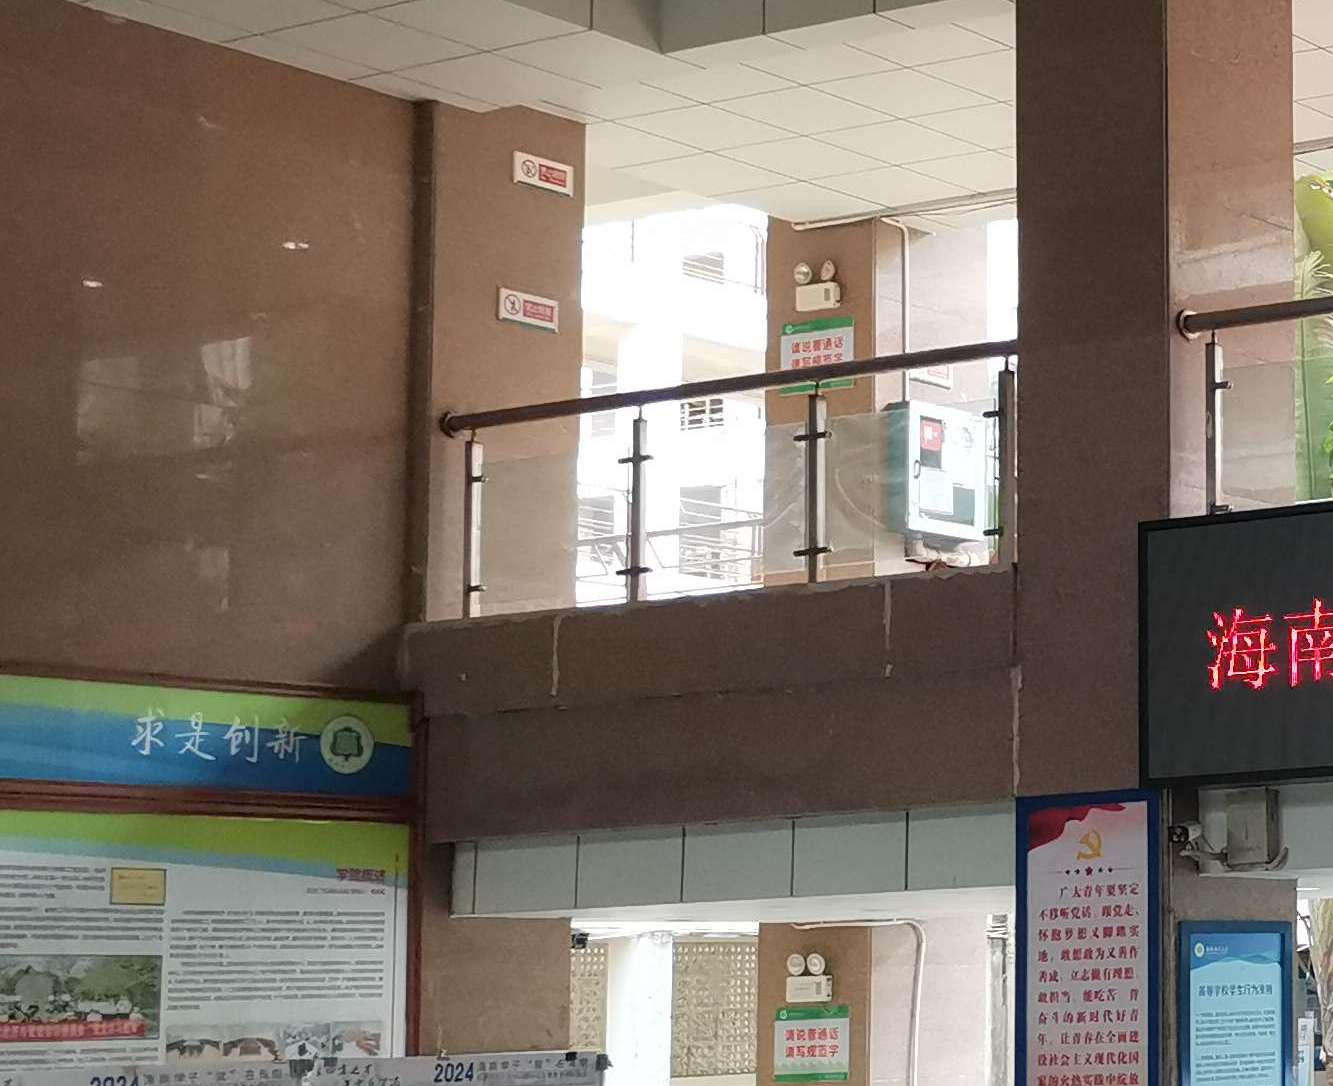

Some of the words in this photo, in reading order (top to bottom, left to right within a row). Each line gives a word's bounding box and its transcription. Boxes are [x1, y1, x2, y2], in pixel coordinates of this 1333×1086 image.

[131, 706, 307, 763] 求是创新
[1060, 883, 1140, 898] 广大青年要坚定
[784, 1027, 839, 1041] 请说普通话
[784, 1044, 839, 1058] 请写规范字
[432, 1062, 475, 1083] 2024
